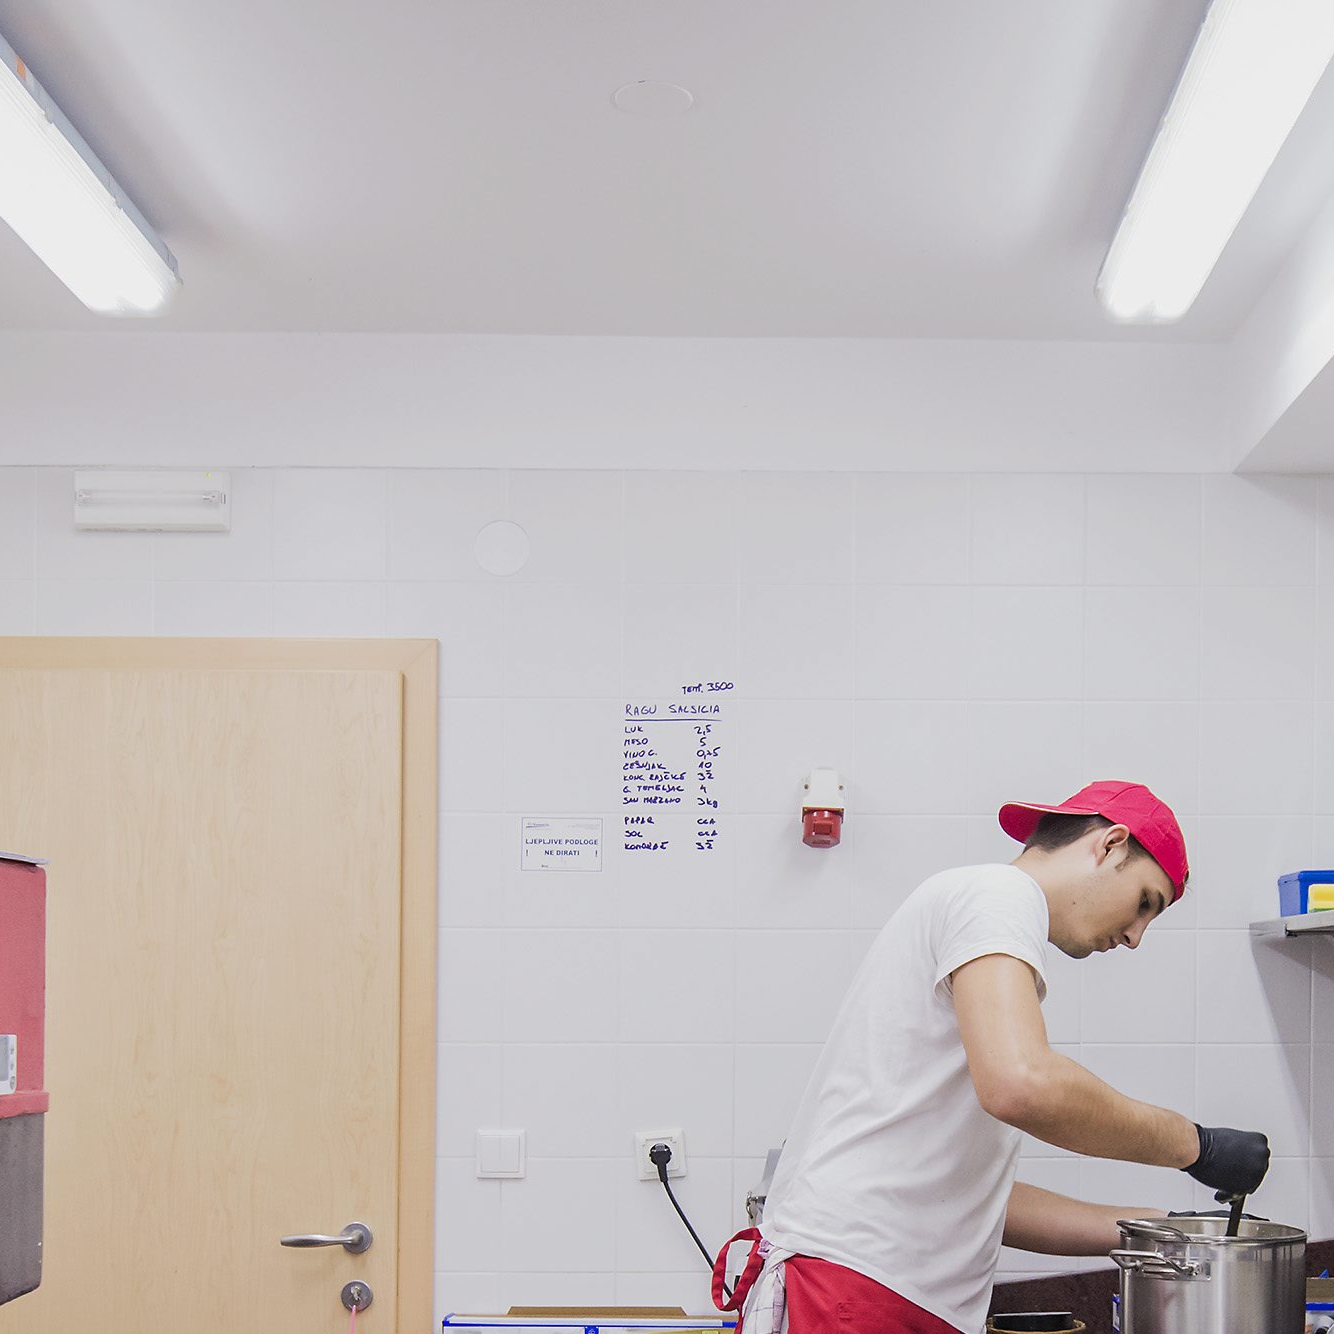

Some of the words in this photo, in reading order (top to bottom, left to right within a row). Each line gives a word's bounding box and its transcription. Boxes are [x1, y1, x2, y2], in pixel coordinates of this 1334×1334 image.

[707, 681, 734, 692] 3500
[625, 703, 657, 716] RAGU
[624, 725, 643, 733] LUK
